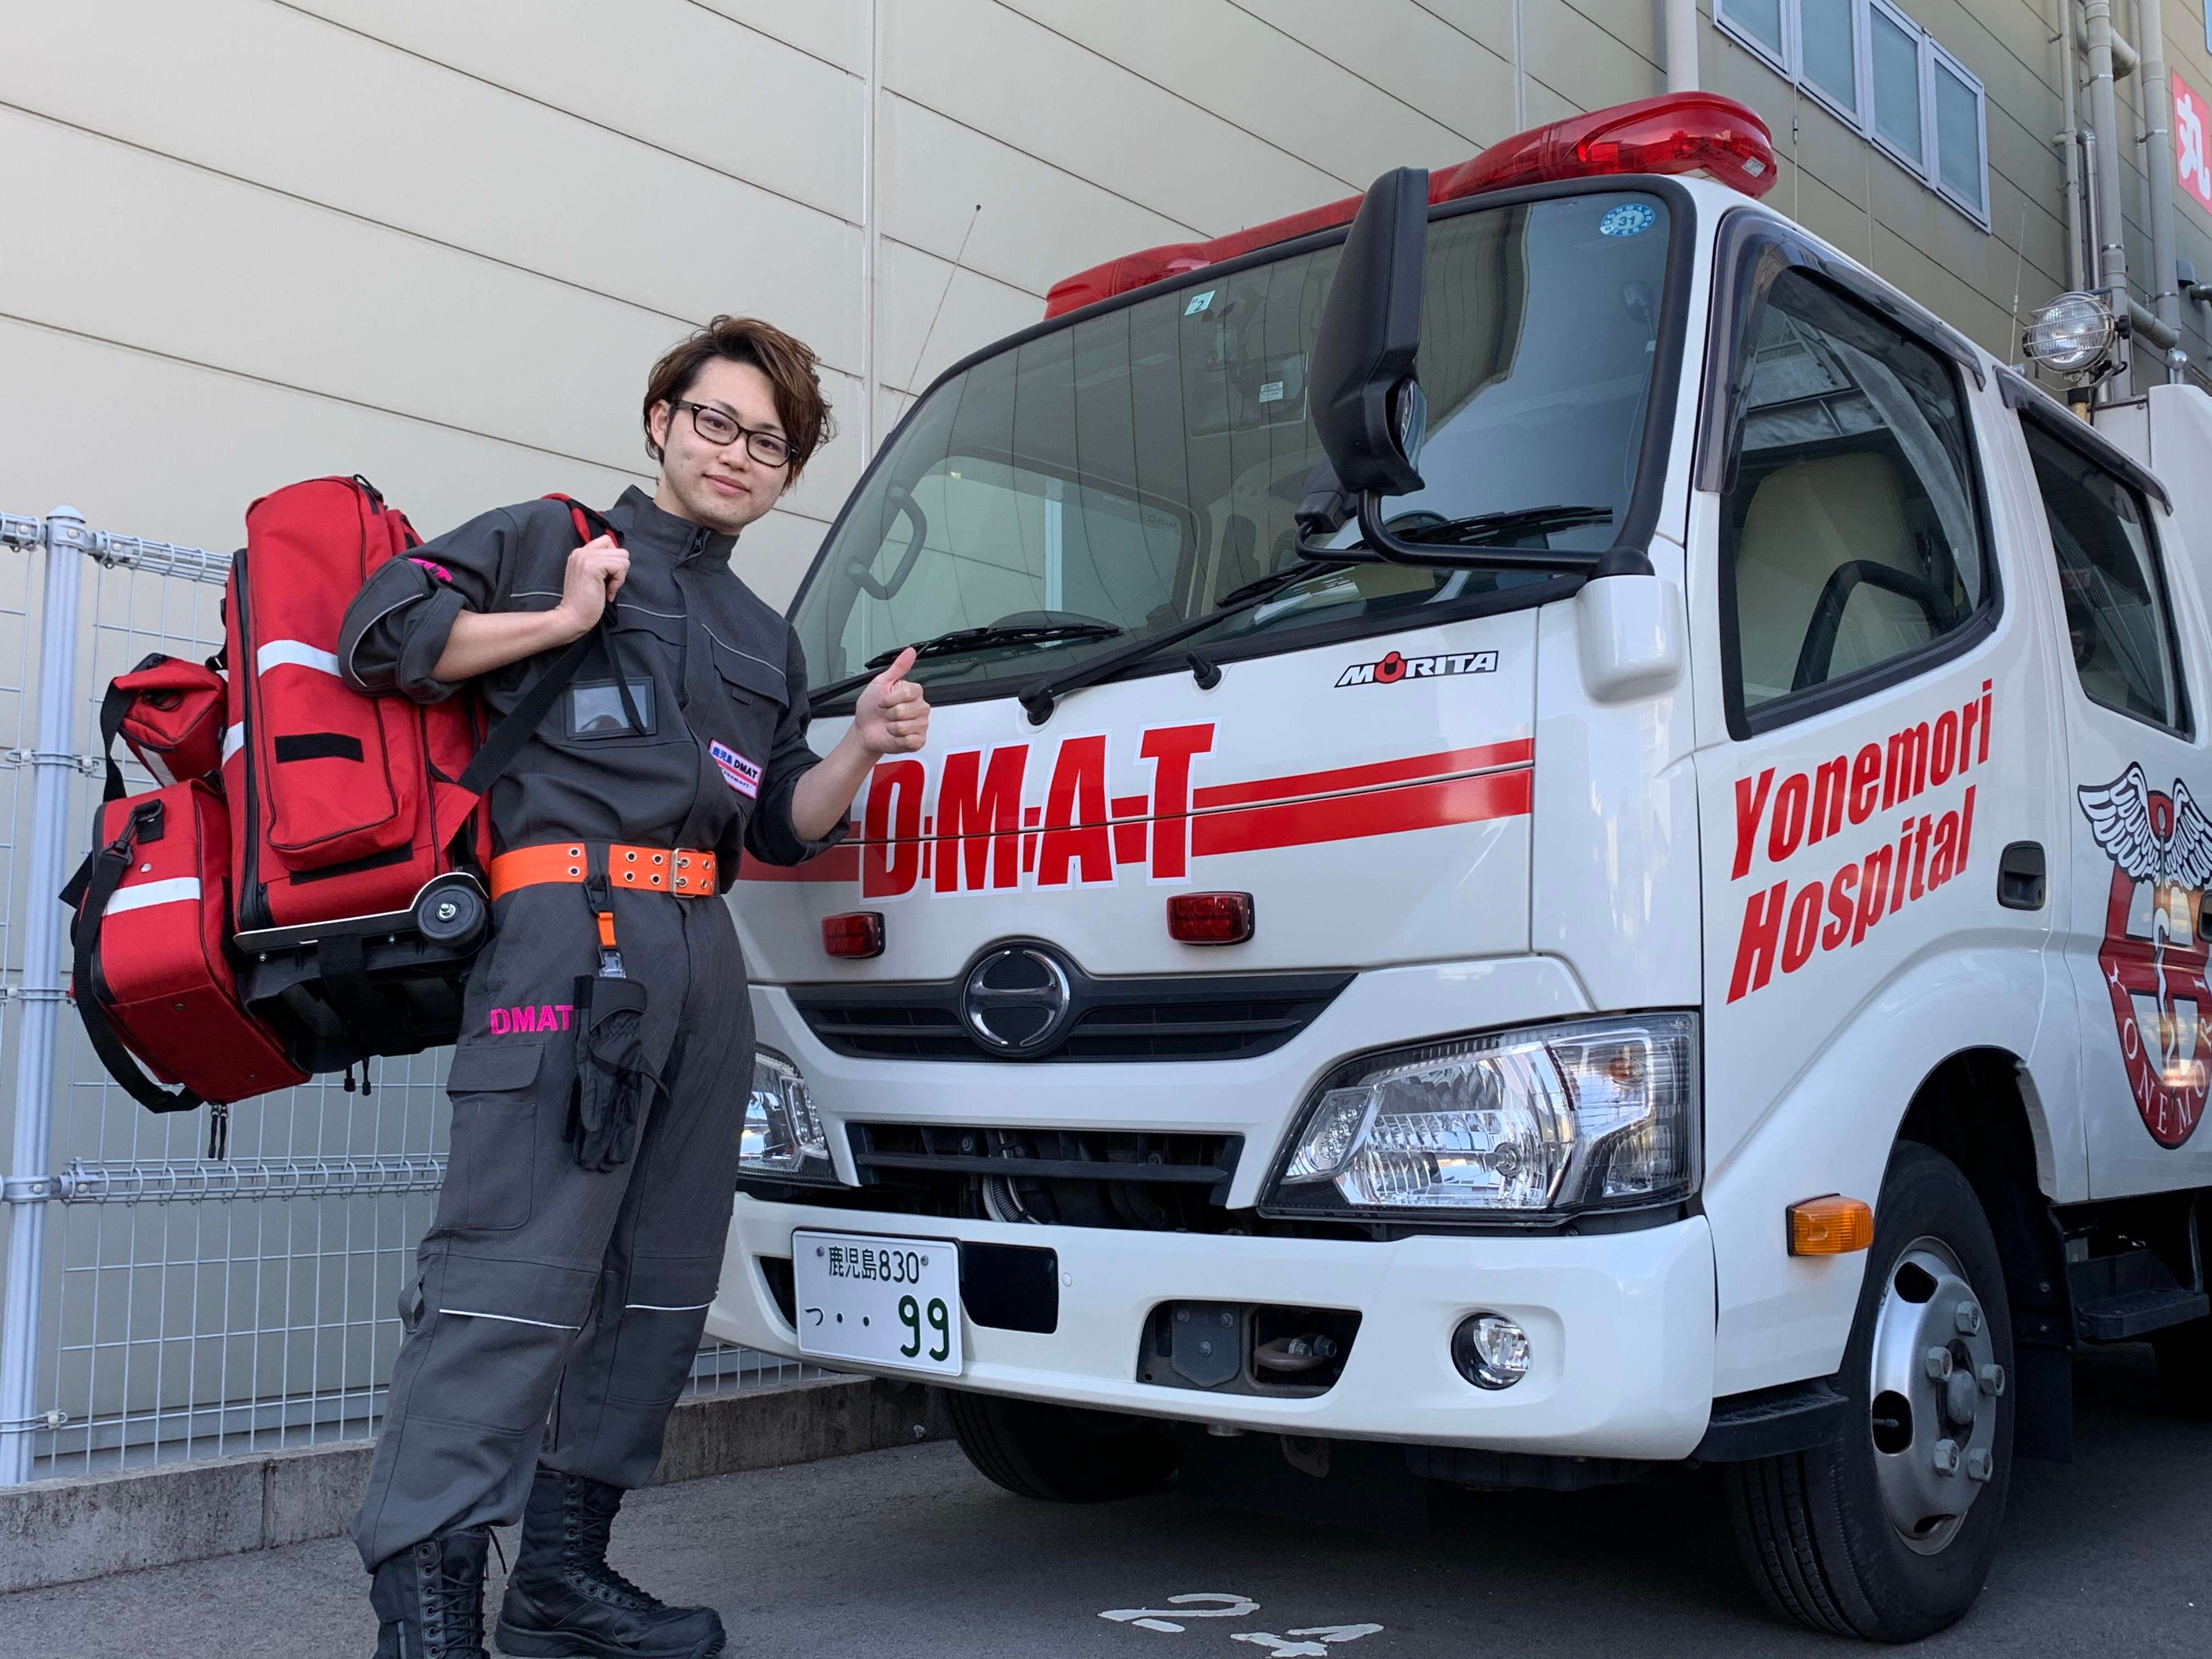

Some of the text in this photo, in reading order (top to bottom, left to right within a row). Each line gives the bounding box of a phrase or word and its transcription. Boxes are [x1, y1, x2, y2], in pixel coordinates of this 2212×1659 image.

[2176, 93, 2210, 200] 丸
[1618, 216, 1635, 227] 31
[1194, 300, 1205, 312] 2
[1335, 651, 1498, 686] MORITA
[734, 759, 758, 779] DMAT
[1731, 678, 1993, 881] Yonemori
[862, 721, 1217, 900] DMAT
[1726, 784, 1976, 1005] Hospital
[490, 1005, 574, 1035] DMAT
[805, 1307, 824, 1326] つ
[898, 1295, 950, 1362] 99
